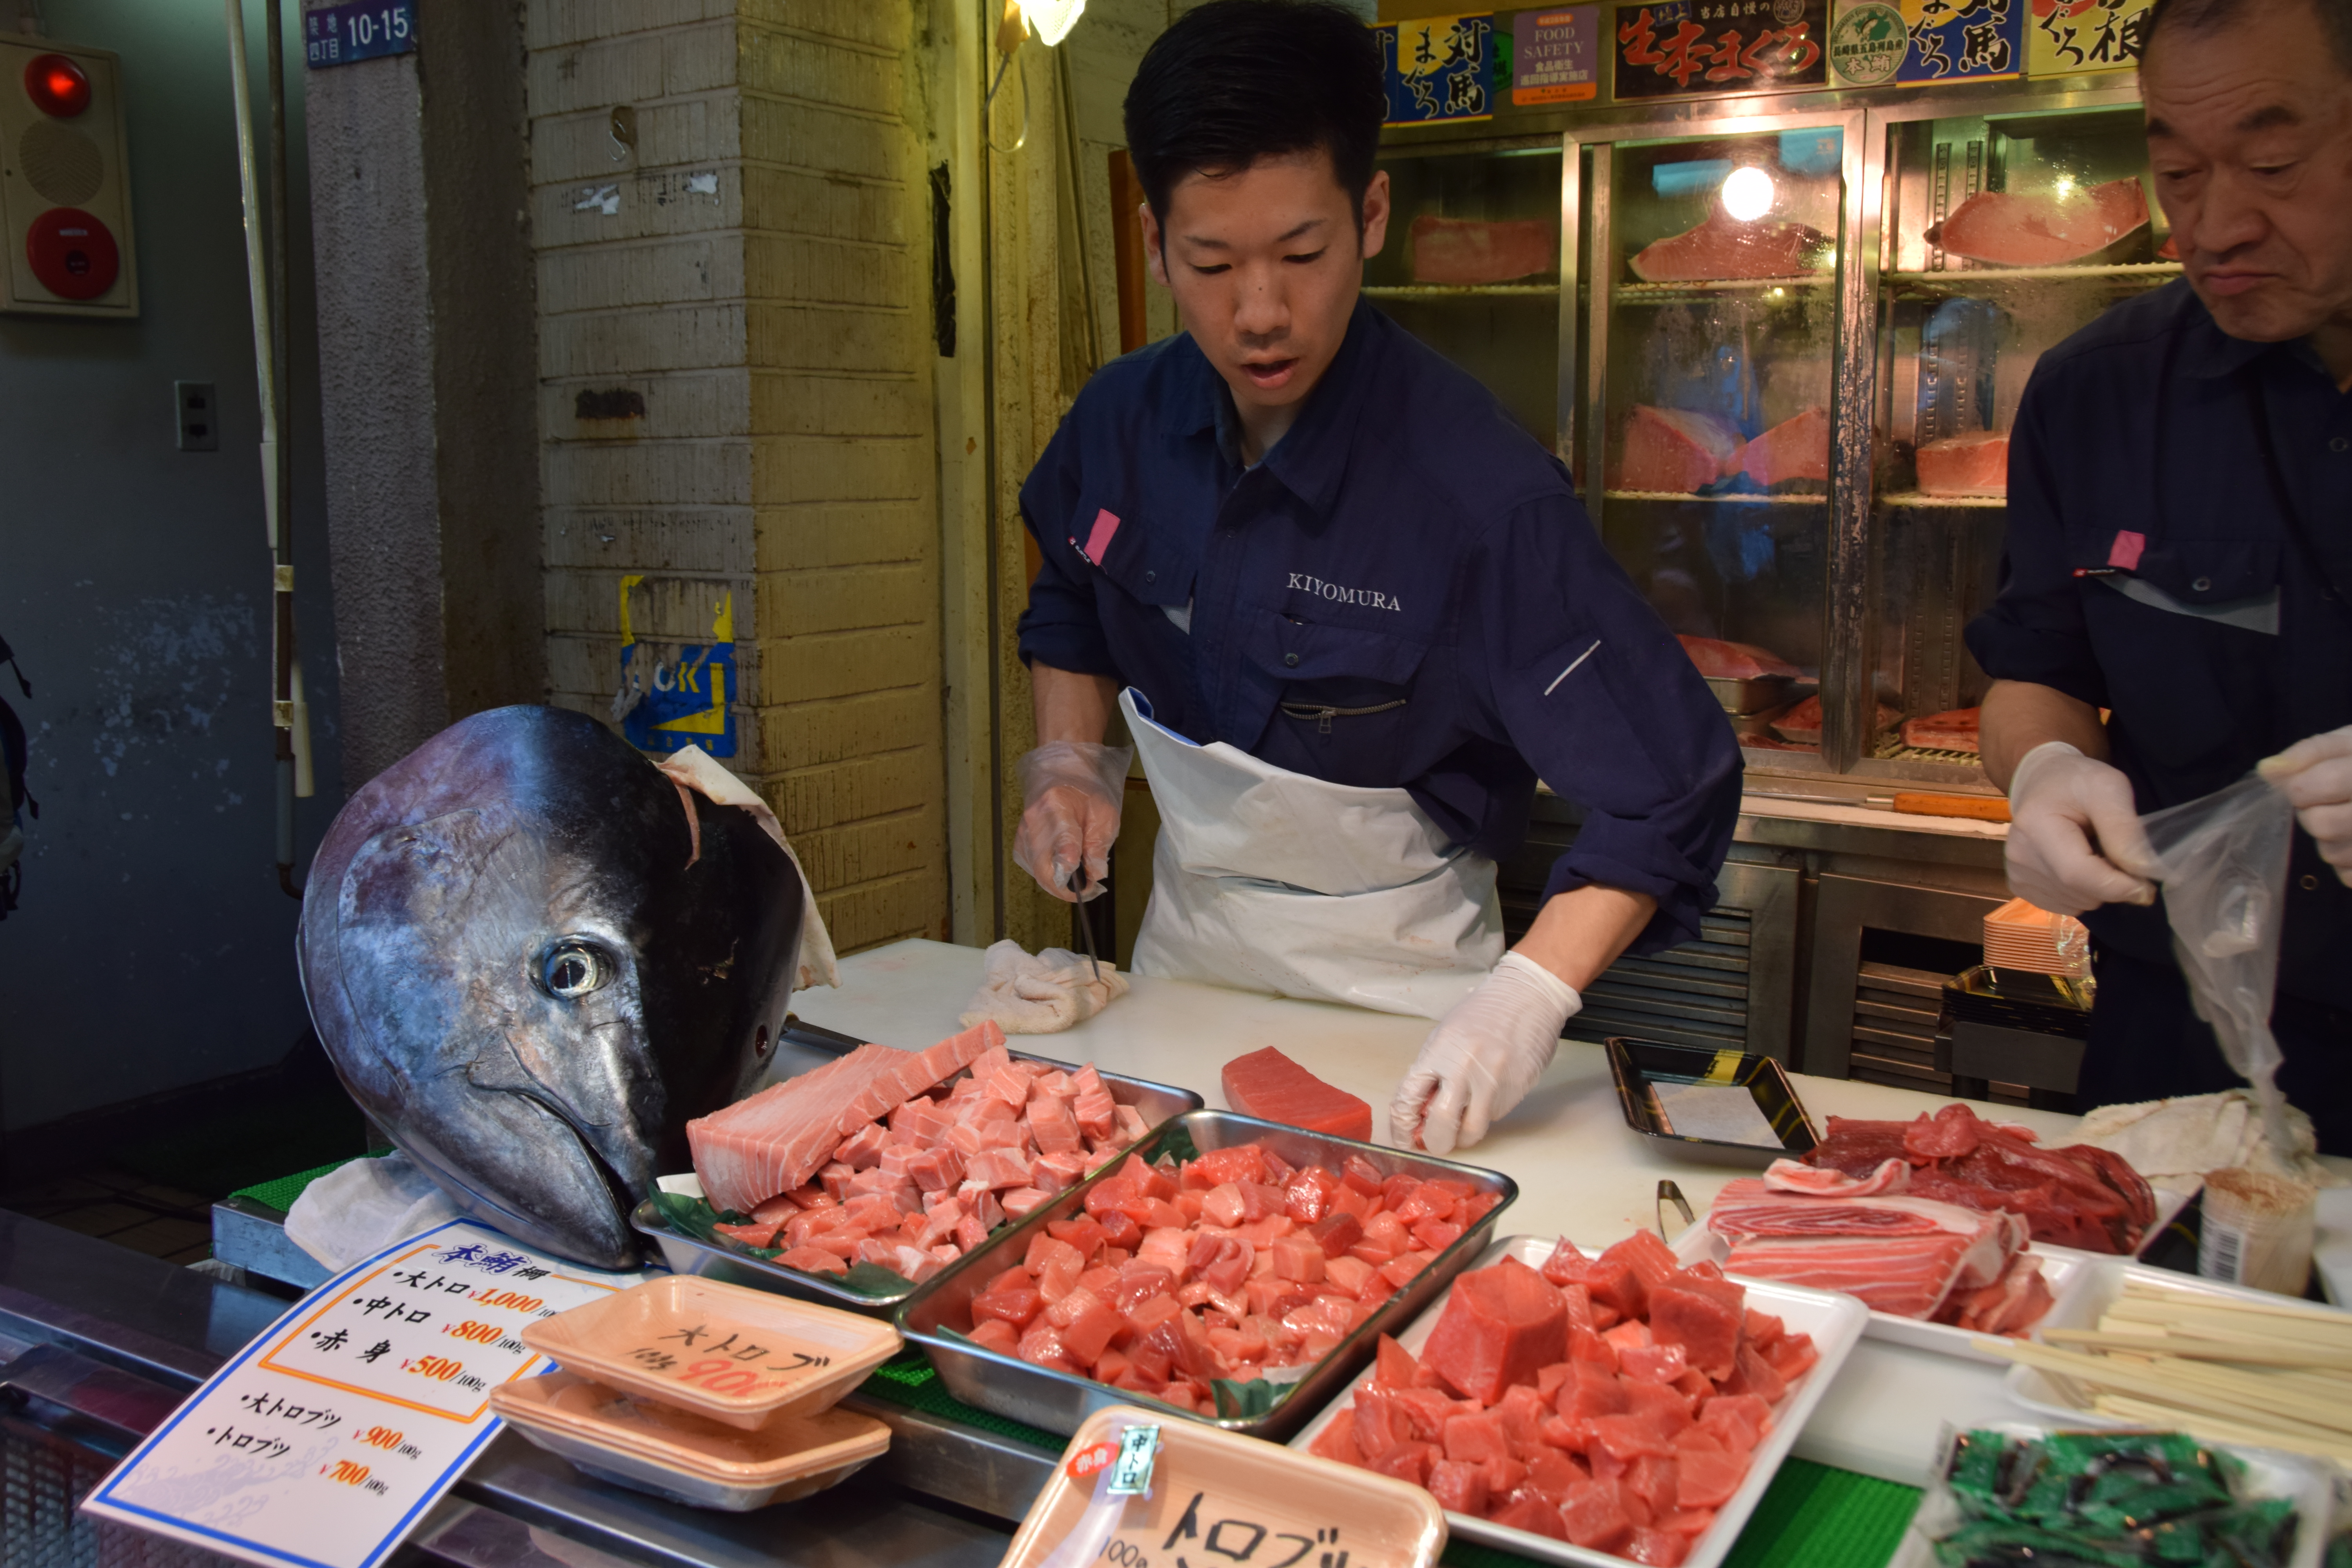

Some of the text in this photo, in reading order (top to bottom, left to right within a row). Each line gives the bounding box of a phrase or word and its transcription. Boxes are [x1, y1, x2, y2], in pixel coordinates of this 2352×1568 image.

[348, 7, 408, 47] 10-15
[1700, 1, 1770, 20] 当店自慢の
[309, 38, 339, 61] 四丁目
[1523, 40, 1584, 59] SAFETY
[1535, 27, 1575, 43] FOOD
[1618, 8, 1820, 87] 生本まぐろ
[2038, 0, 2084, 71] ぐろ
[1401, 25, 1439, 119] まぐろ
[1441, 20, 1490, 114] 対馬
[1286, 572, 1401, 612] KIYOMURA
[395, 1271, 470, 1294] 大トロ
[363, 1296, 431, 1323] 中トロ
[242, 1392, 341, 1430] 大トロブツ
[214, 1426, 290, 1459] トロブツ
[1123, 1434, 1148, 1484] 中トロ
